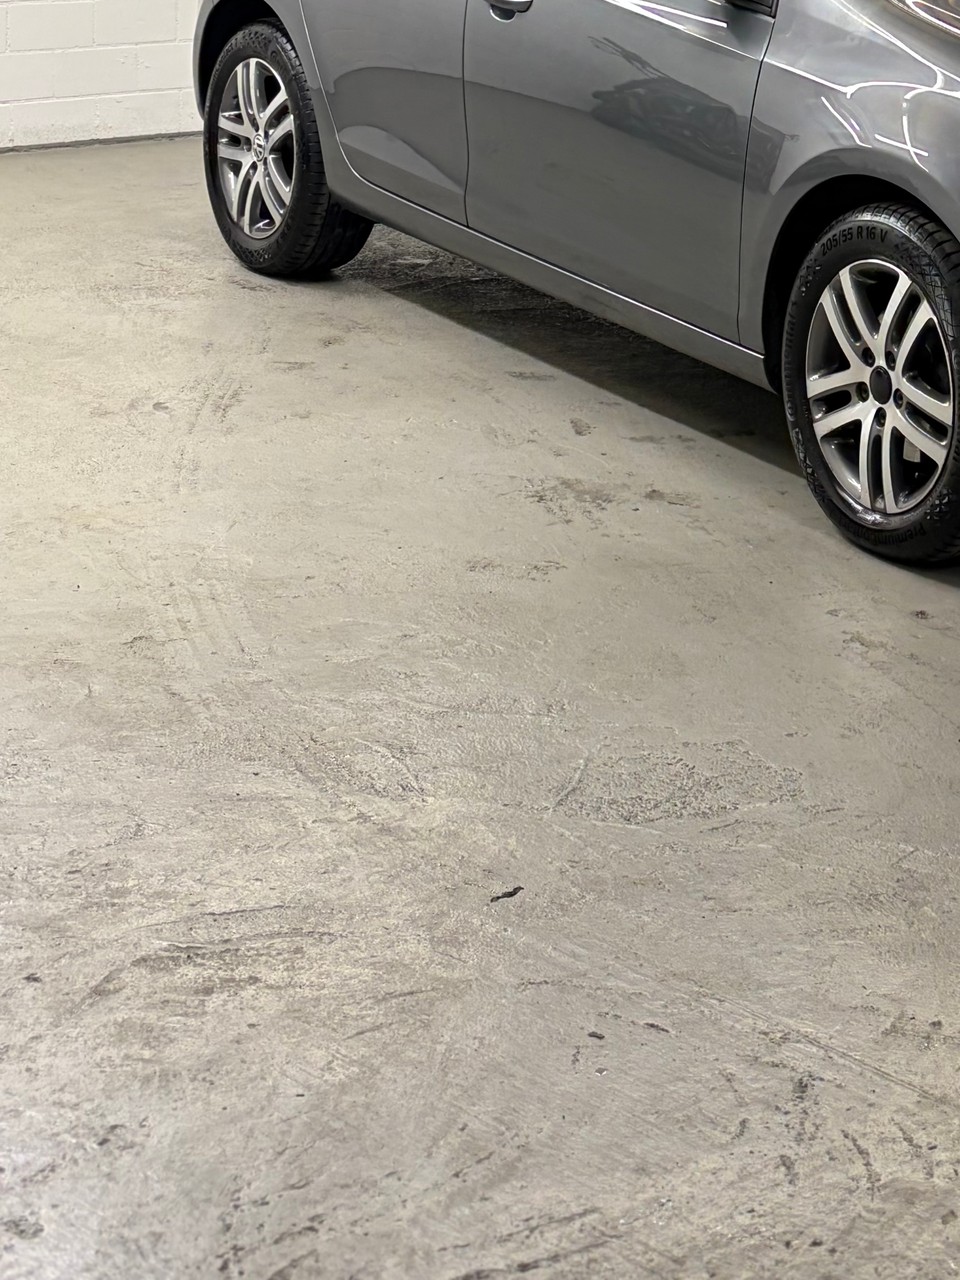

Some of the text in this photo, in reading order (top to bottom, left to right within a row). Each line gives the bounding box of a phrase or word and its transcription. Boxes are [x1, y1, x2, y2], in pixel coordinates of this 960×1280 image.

[820, 225, 889, 256] 205/55 R 16 V
